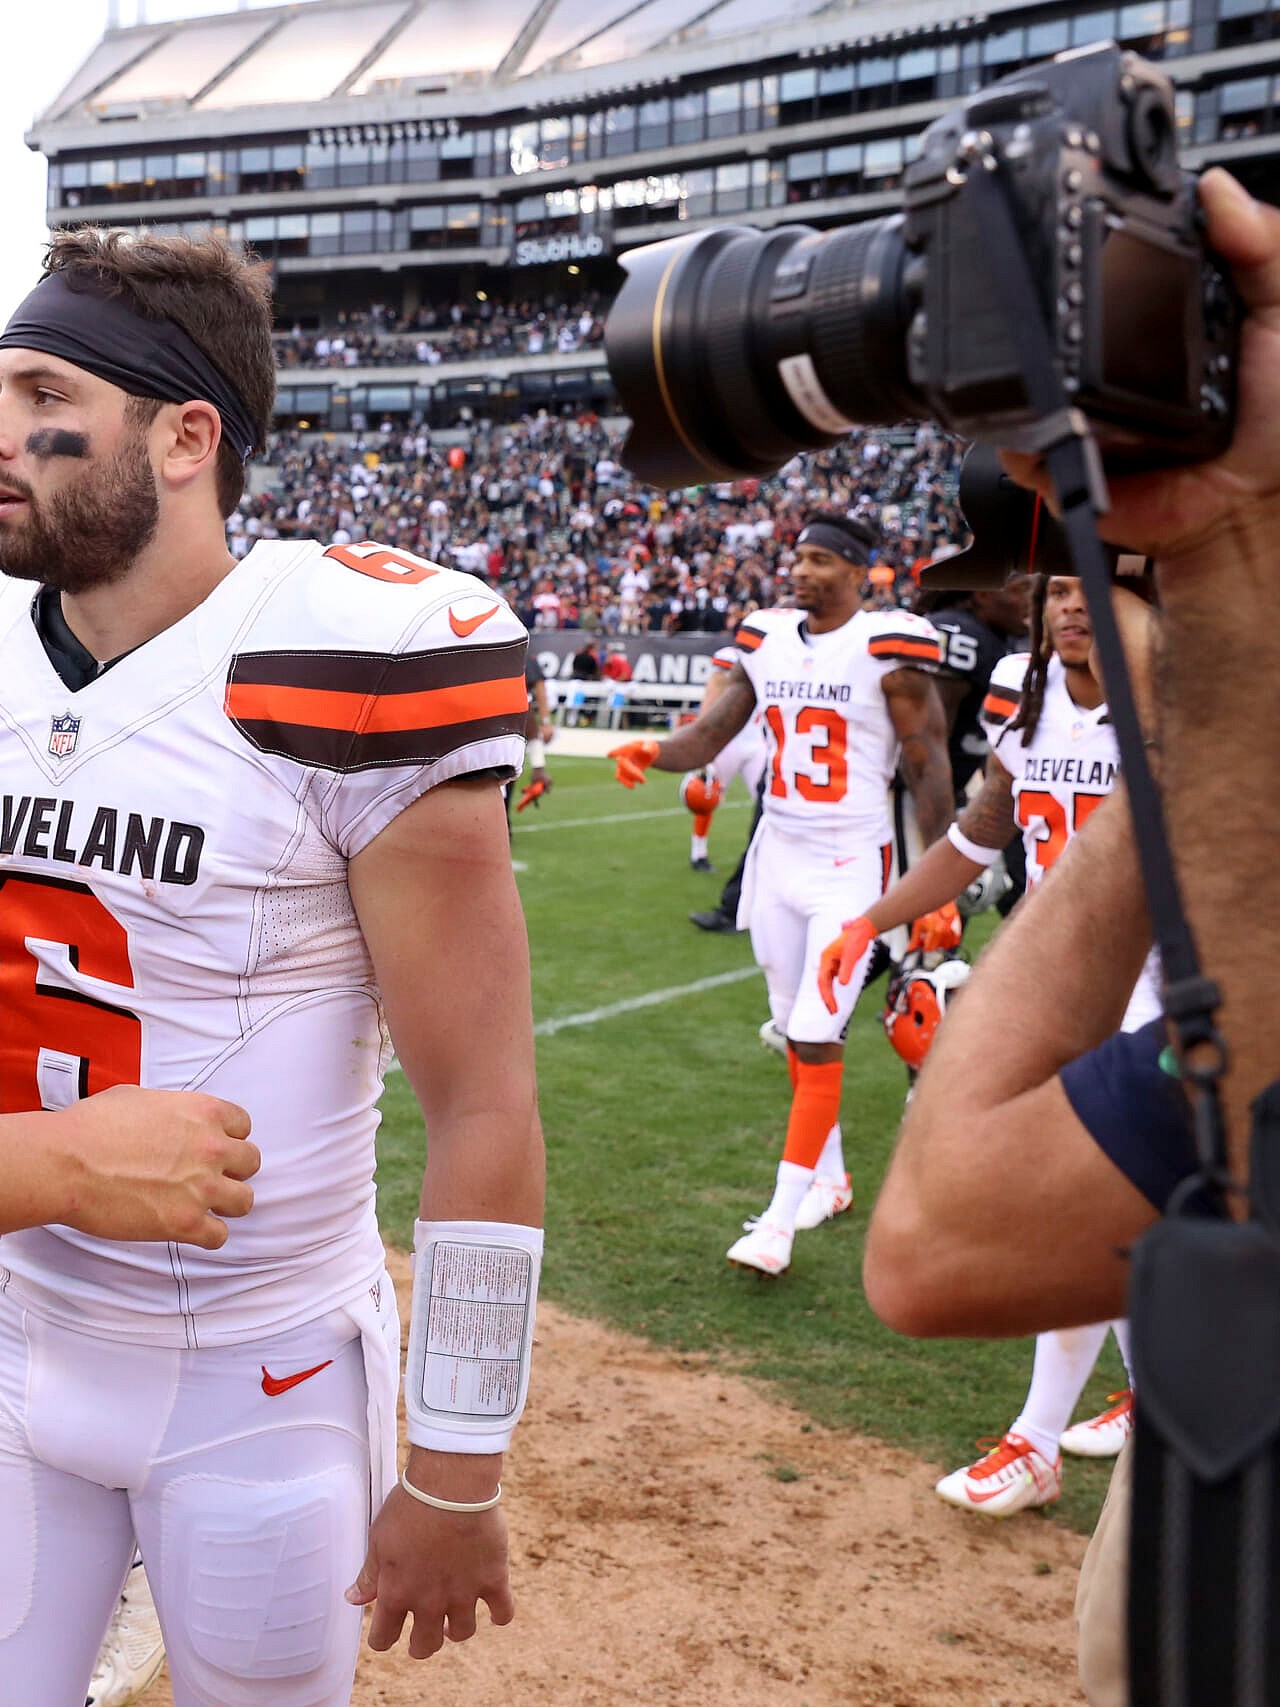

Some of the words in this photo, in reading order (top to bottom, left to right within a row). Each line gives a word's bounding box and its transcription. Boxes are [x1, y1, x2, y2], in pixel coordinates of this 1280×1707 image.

[516, 235, 604, 266] StubHub
[322, 542, 440, 585] 6
[765, 681, 852, 703] CLEVELAND
[51, 733, 74, 754] NFL
[765, 704, 848, 803] 13
[1024, 759, 1120, 787] CLEVELAN
